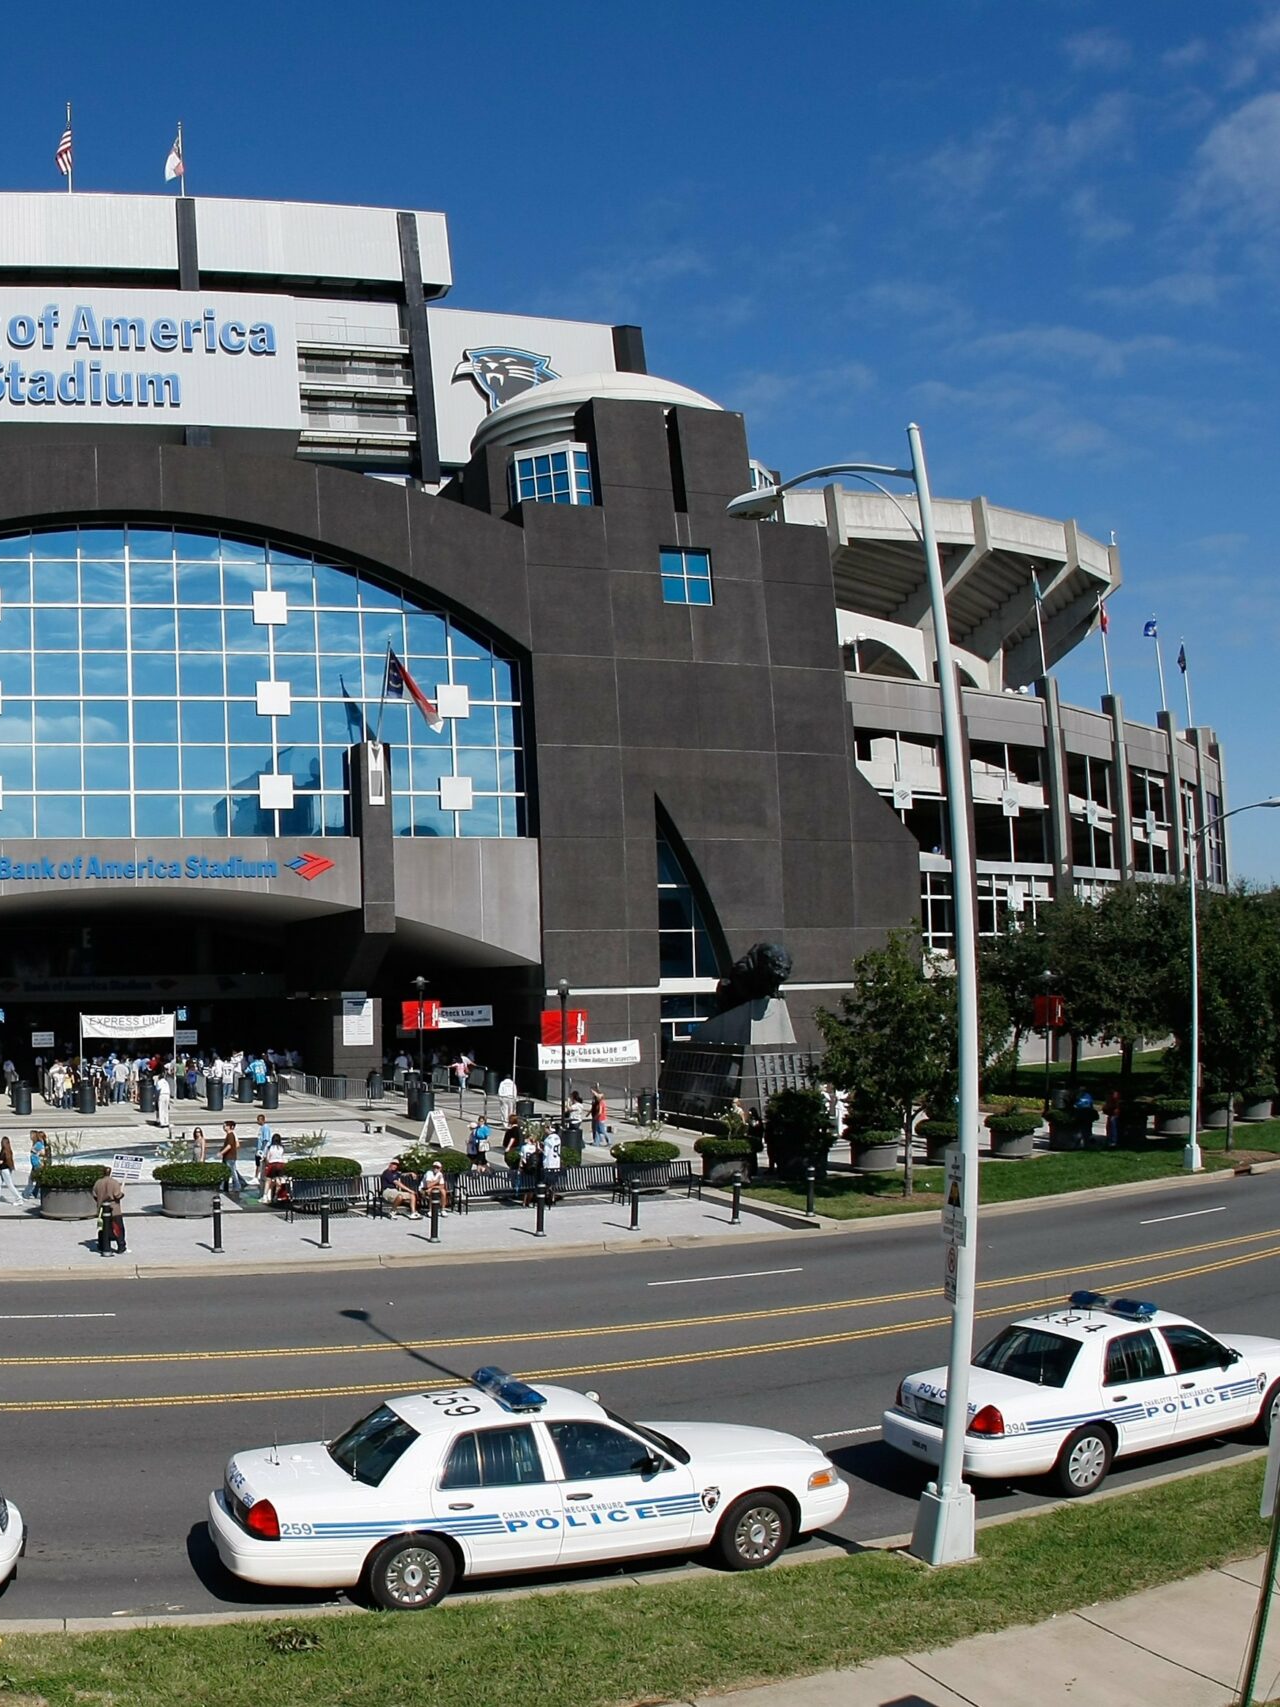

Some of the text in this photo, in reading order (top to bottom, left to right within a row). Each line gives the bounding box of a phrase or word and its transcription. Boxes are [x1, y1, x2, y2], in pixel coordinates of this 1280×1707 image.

[7, 303, 60, 350] of
[66, 305, 277, 356] America
[58, 856, 83, 880] of
[85, 856, 181, 880] America
[184, 856, 277, 879] Stadium
[89, 1015, 166, 1026] EXPRESS LINE
[564, 1046, 617, 1057] ag-Check Line
[917, 1383, 948, 1398] POLIC
[421, 1390, 481, 1416] 259
[1144, 1396, 1173, 1407] CHARLOTTE
[1146, 1390, 1231, 1418] POLICE
[1005, 1422, 1026, 1434] 394
[502, 1501, 624, 1520] CHARLOTTE MECKLENBURG
[506, 1507, 658, 1533] POLICE
[280, 1523, 312, 1535] 259
